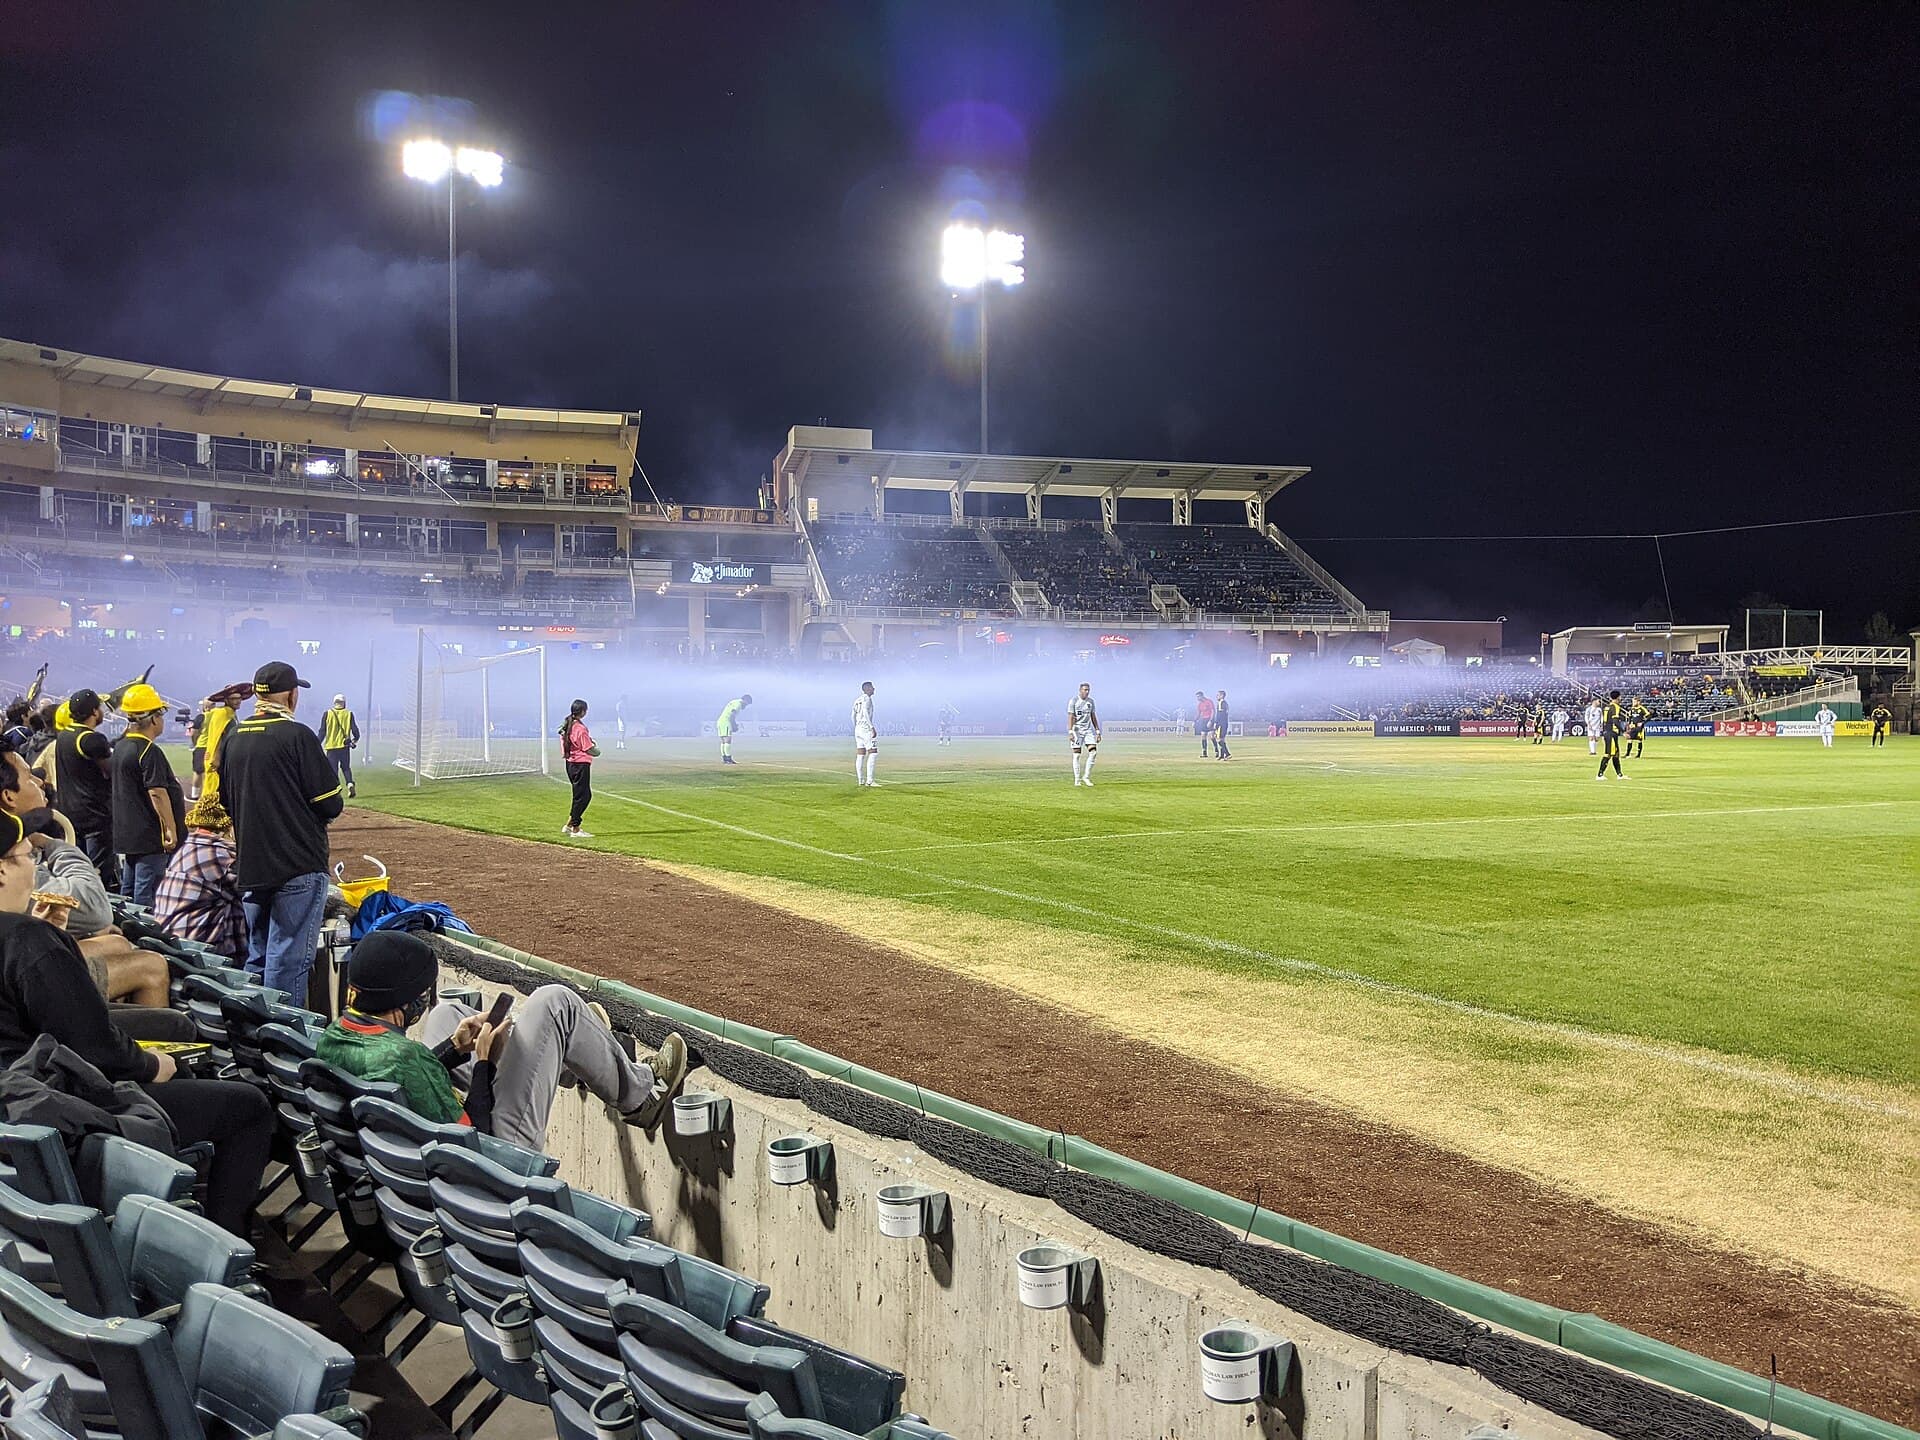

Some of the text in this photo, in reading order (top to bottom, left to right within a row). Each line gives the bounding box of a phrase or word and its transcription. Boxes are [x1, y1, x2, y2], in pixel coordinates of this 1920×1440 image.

[716, 563, 755, 580] Jimador
[1669, 725, 1691, 733] WHAT
[1846, 722, 1869, 730] Weichert
